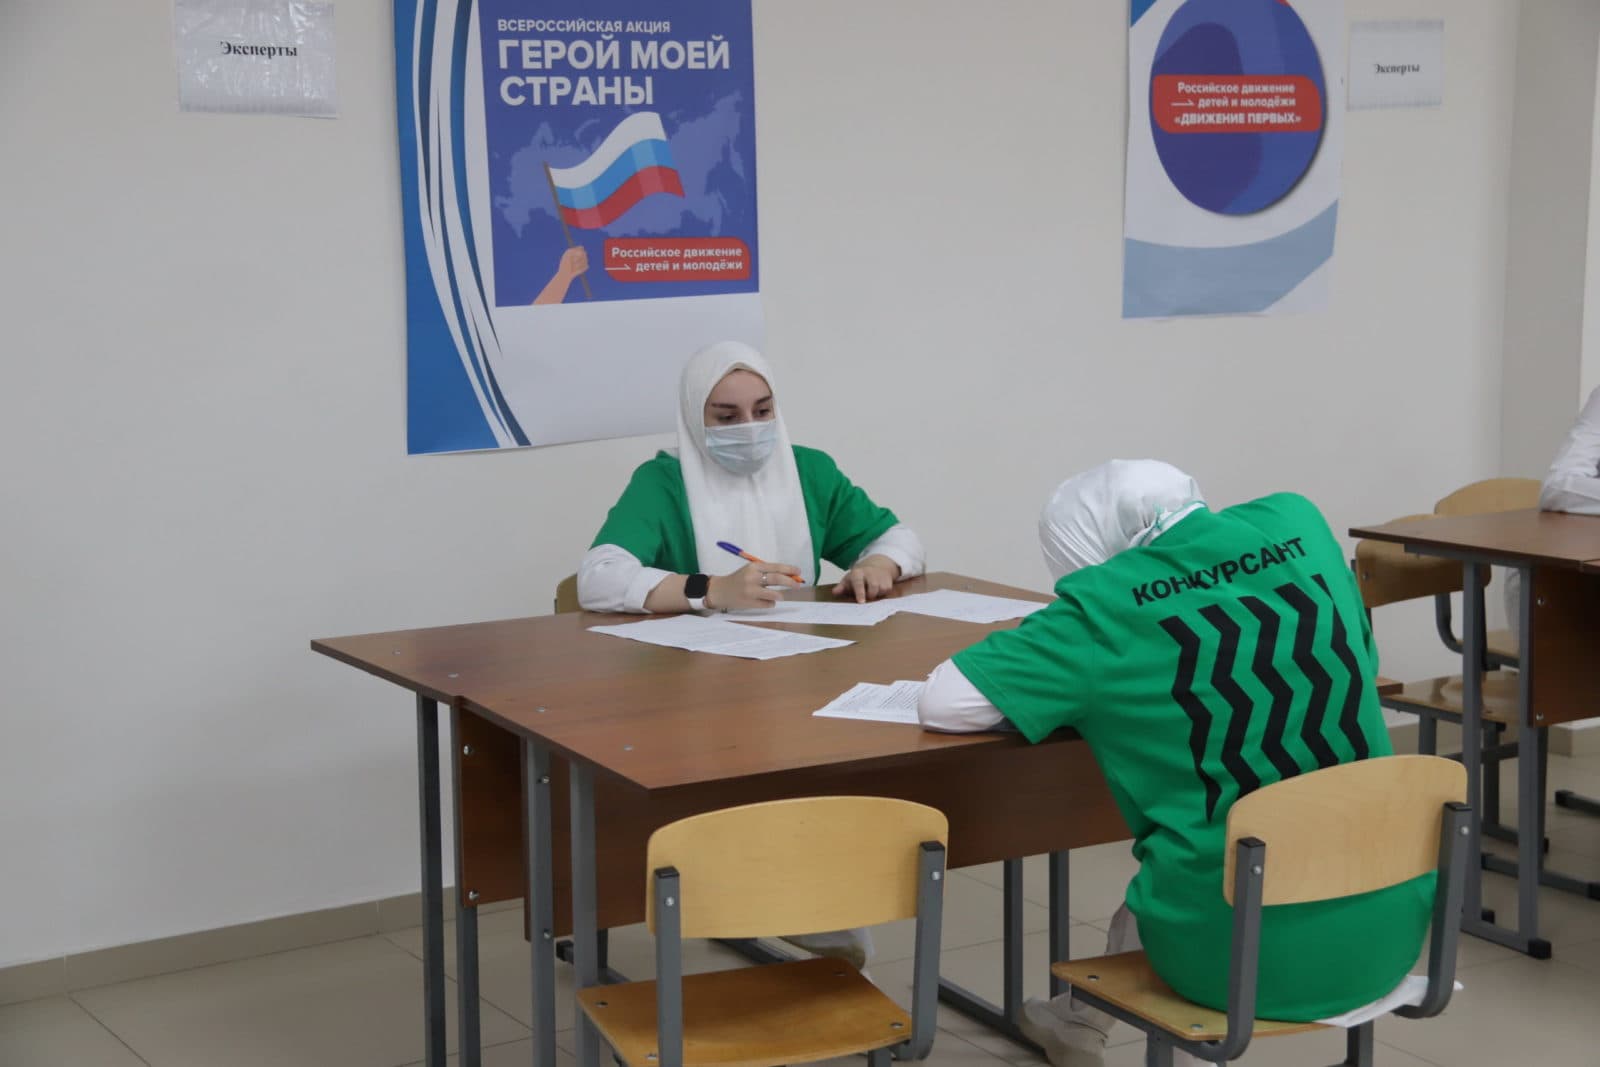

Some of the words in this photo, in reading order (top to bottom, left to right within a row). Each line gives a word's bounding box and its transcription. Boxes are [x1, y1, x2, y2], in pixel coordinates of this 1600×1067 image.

[497, 18, 622, 33] ВСЕРОССИЙСКАЯ
[625, 21, 671, 34] АКЦИЯ
[220, 41, 298, 60] Эксперты
[498, 34, 620, 70] ГЕРОЙ
[631, 34, 730, 70] МОЕЙ
[1374, 63, 1421, 76] Эксперты
[500, 76, 654, 106] СТРАНЫ
[1177, 82, 1239, 94] Российское
[1241, 83, 1296, 95] движение
[1197, 96, 1229, 108] детей
[1231, 99, 1238, 107] и
[1240, 96, 1296, 108] молодёжи
[1174, 113, 1246, 126] «ДВИЖЕНИЕ
[1247, 112, 1302, 124] ПЕРВЫХ»
[611, 247, 681, 258] Российское
[683, 247, 743, 259] движение
[635, 260, 670, 273] детей
[672, 263, 680, 271] и
[682, 259, 743, 272] молодёжи
[1131, 537, 1307, 607] КОНКУРСАНТ
